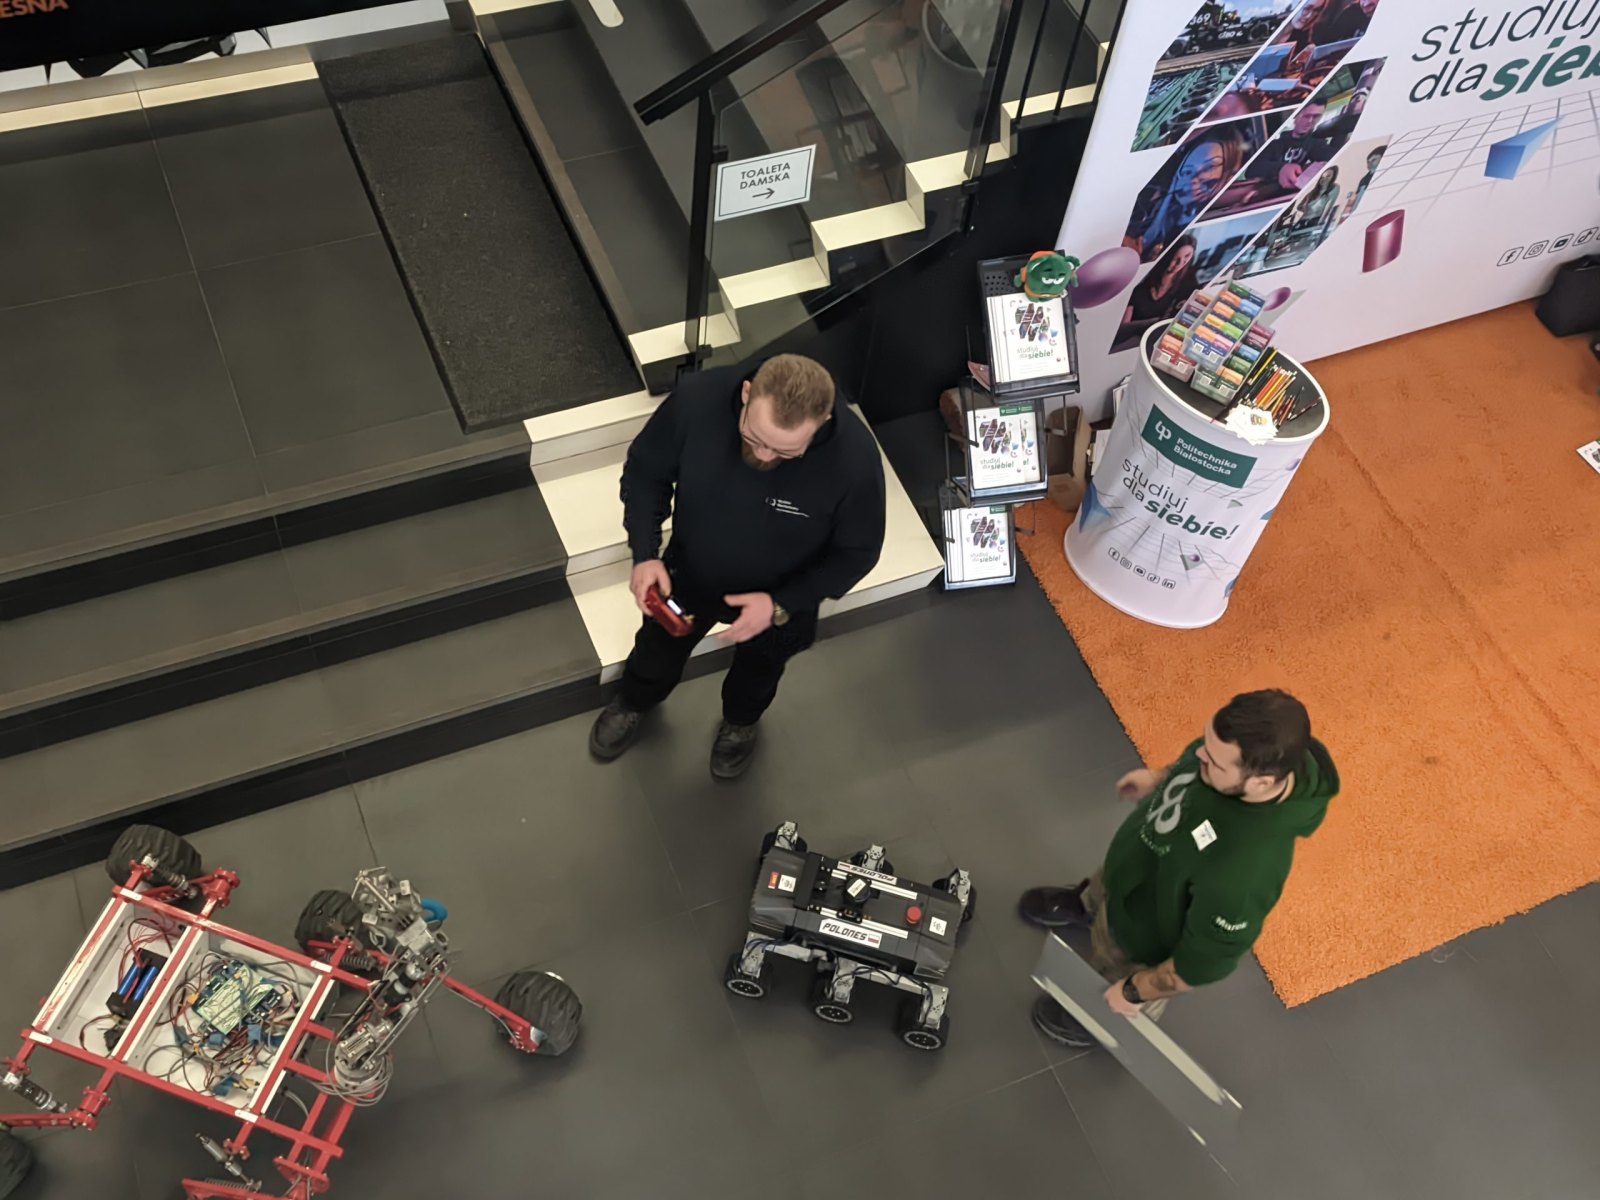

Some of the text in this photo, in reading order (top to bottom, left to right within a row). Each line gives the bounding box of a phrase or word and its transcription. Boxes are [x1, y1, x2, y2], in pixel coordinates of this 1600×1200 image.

[1409, 57, 1488, 103] dla
[739, 172, 791, 190] DAMSKA
[740, 162, 791, 180] TOALETA
[1028, 349, 1054, 359] siebie!
[1176, 437, 1238, 469] Politechnika
[1122, 458, 1188, 513] studiuj
[1122, 477, 1240, 540] dla siebie!
[822, 922, 868, 941] POLONES
